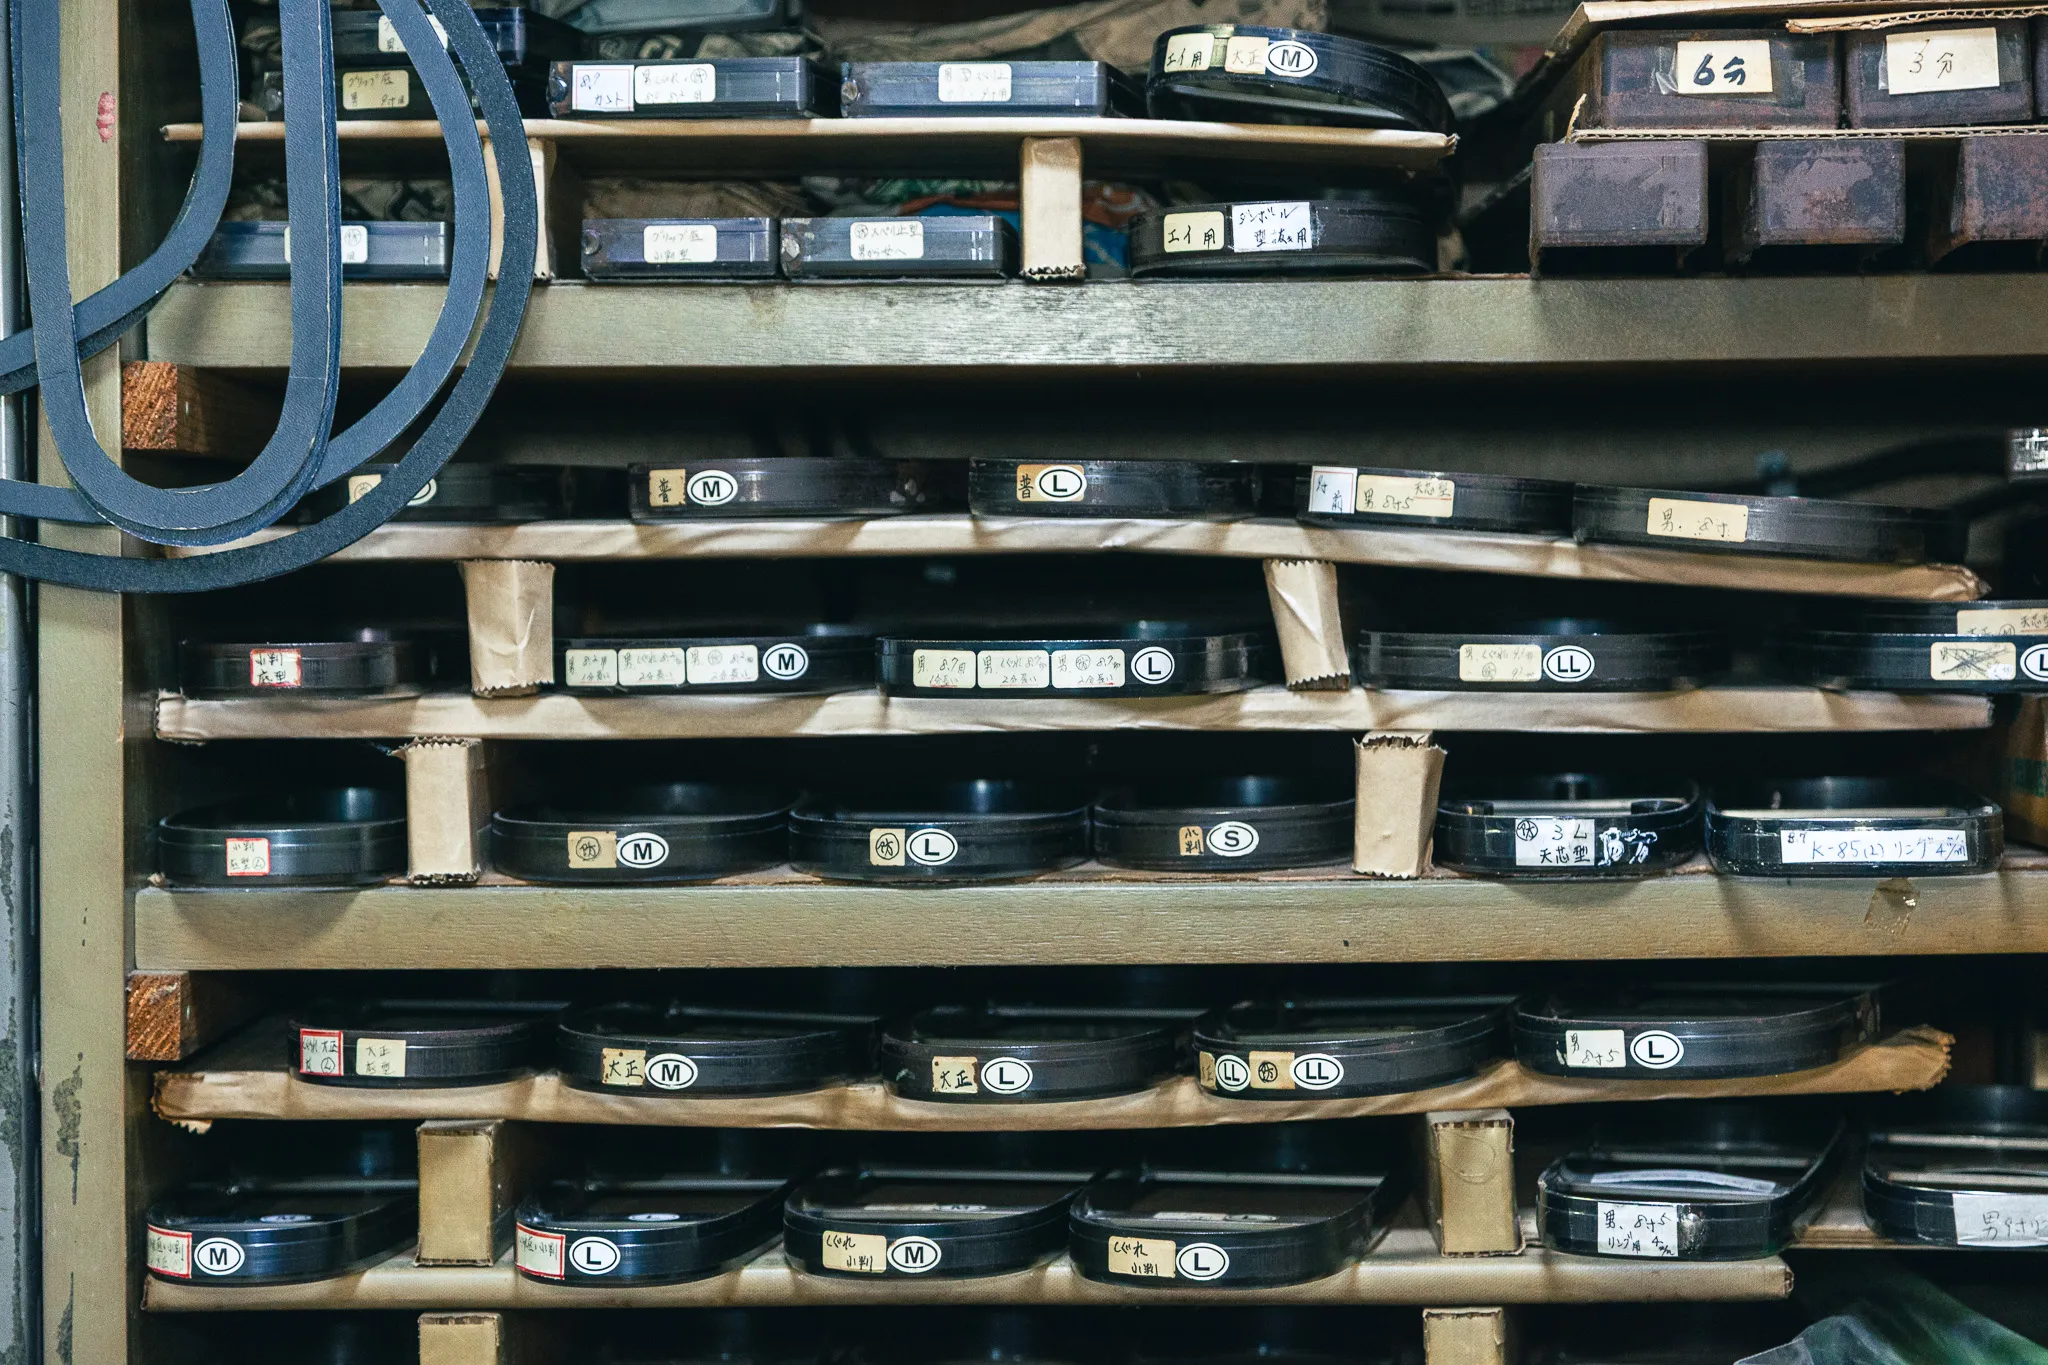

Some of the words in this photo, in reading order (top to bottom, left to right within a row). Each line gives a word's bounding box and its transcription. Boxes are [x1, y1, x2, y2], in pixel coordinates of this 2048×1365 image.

[1232, 49, 1262, 68] 大正
[1280, 49, 1302, 69] M
[1693, 52, 1745, 85] 6分
[703, 481, 721, 498] M
[1053, 475, 1068, 492] L
[779, 653, 796, 670] M
[1148, 657, 1162, 675] L
[1558, 655, 1581, 673] LL
[925, 838, 940, 856] L
[1224, 831, 1241, 848] S
[634, 843, 652, 860] M
[1540, 845, 1590, 865] 天芯型
[1649, 1041, 1665, 1058] L
[609, 1059, 644, 1080] 大正
[662, 1064, 681, 1082] M
[999, 1067, 1015, 1084] L
[1223, 1062, 1241, 1082] LL
[1305, 1062, 1329, 1079] LL
[939, 1070, 974, 1089] 大正
[210, 1248, 228, 1265] M
[587, 1247, 602, 1264] L
[846, 1255, 874, 1272] 小判
[905, 1247, 923, 1264] M
[1194, 1253, 1210, 1271] L
[1131, 1263, 1159, 1277] 小判
